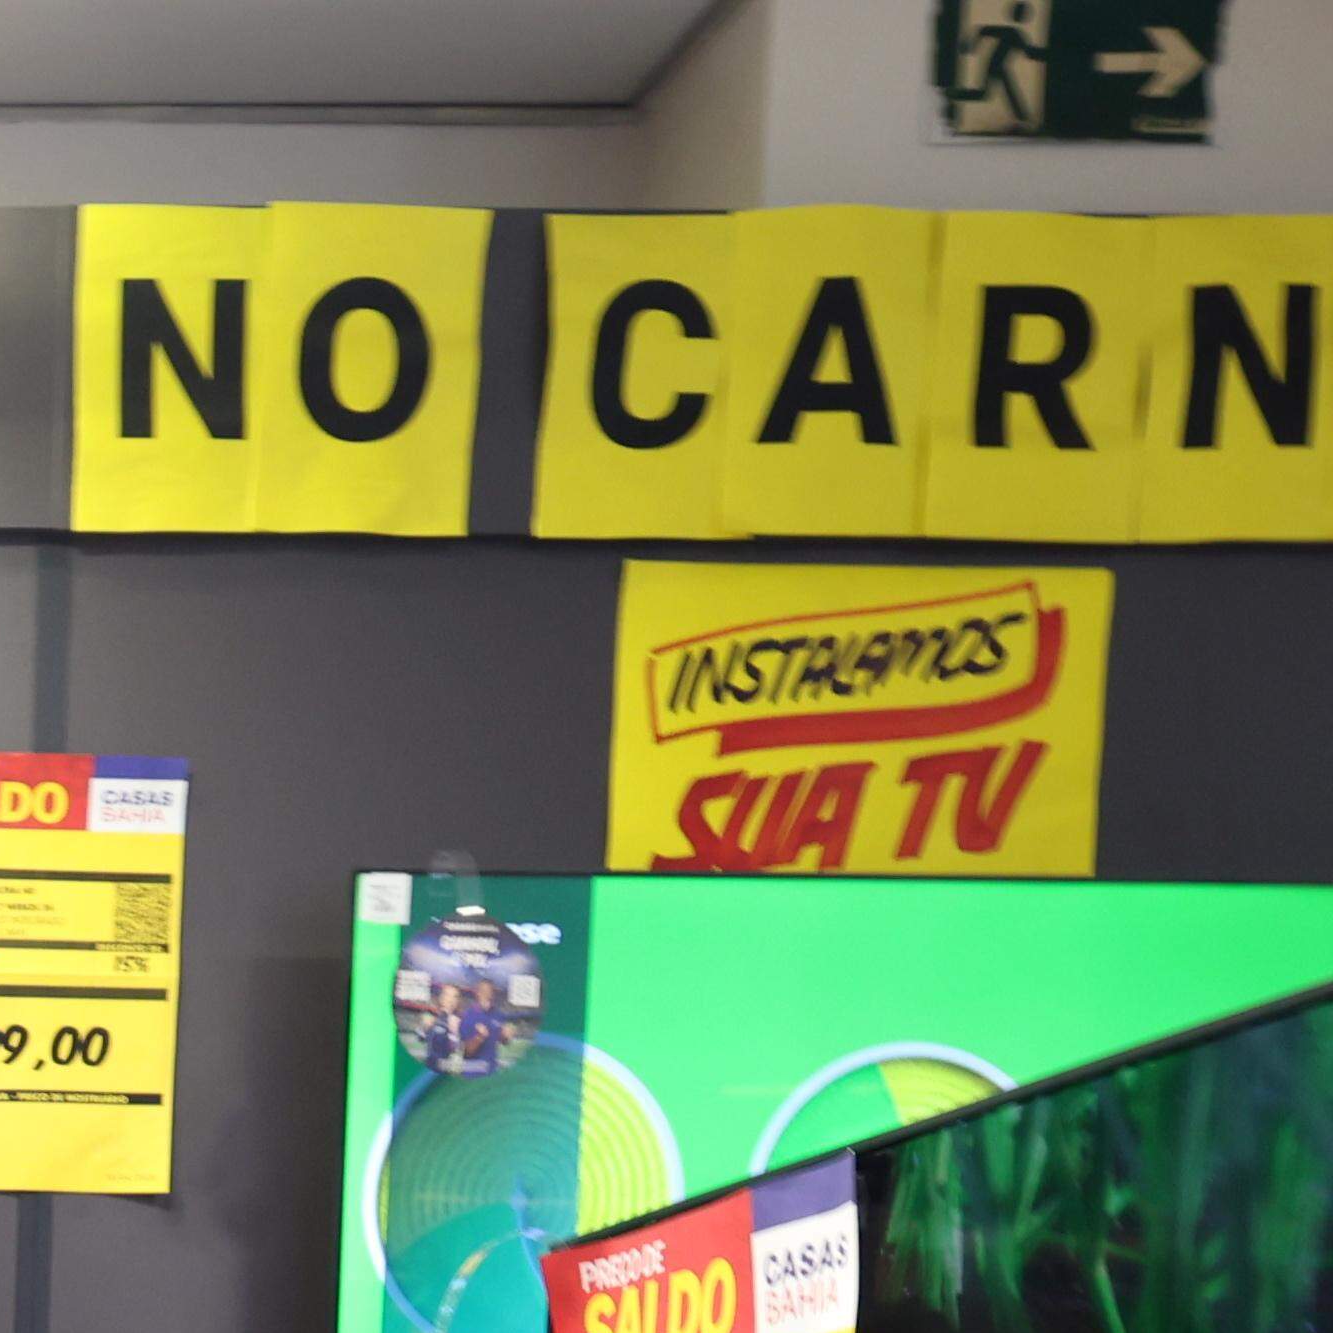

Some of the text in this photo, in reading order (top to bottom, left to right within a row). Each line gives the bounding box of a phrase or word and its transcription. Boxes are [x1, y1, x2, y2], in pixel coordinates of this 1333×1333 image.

[117, 276, 432, 443] NO
[589, 276, 1320, 451] CARN
[669, 611, 1027, 714] INSTALAMOS
[101, 790, 174, 807] CASAS
[101, 809, 166, 823] BAHIA
[650, 740, 1049, 872] SUA TV
[764, 1234, 849, 1286] CASAS
[767, 1279, 840, 1326] BAHIA
